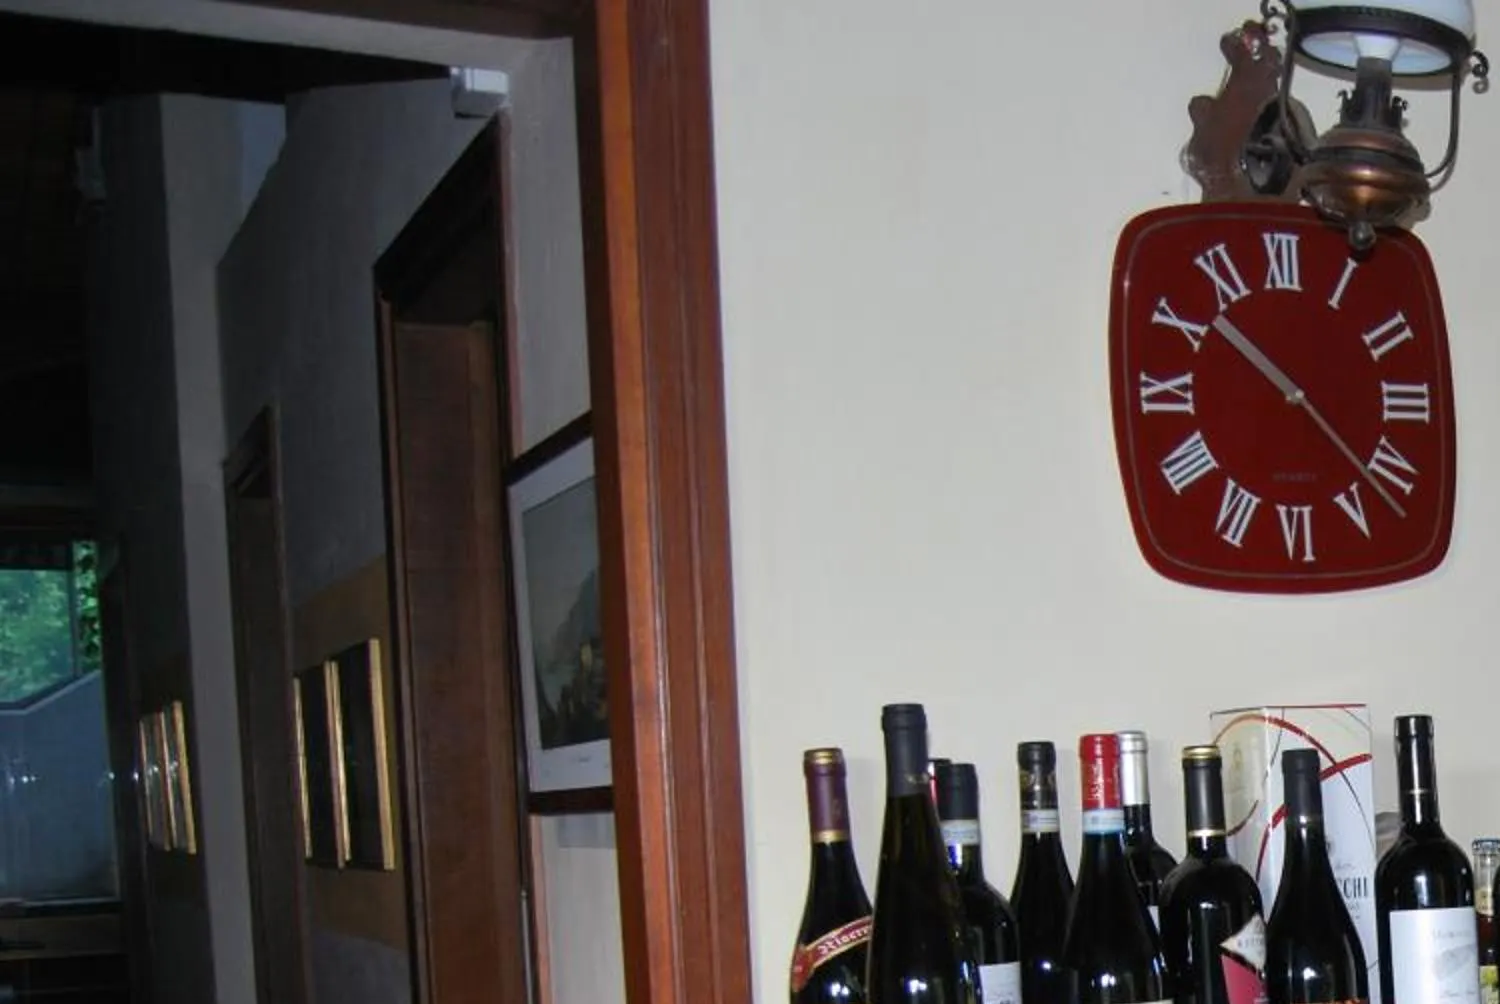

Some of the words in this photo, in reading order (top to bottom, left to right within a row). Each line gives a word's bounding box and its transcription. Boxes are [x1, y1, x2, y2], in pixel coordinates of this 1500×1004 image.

[1194, 243, 1253, 312] XI
[1262, 231, 1304, 292] XII
[1327, 257, 1359, 310] I
[1151, 296, 1210, 353] X
[1361, 310, 1414, 362] II
[1139, 371, 1195, 415] IX
[1380, 380, 1431, 424] III
[1160, 430, 1220, 496] VIII
[1367, 435, 1421, 496] IV
[1214, 477, 1262, 548] VII
[1275, 503, 1316, 563] VI
[1333, 481, 1371, 540] V
